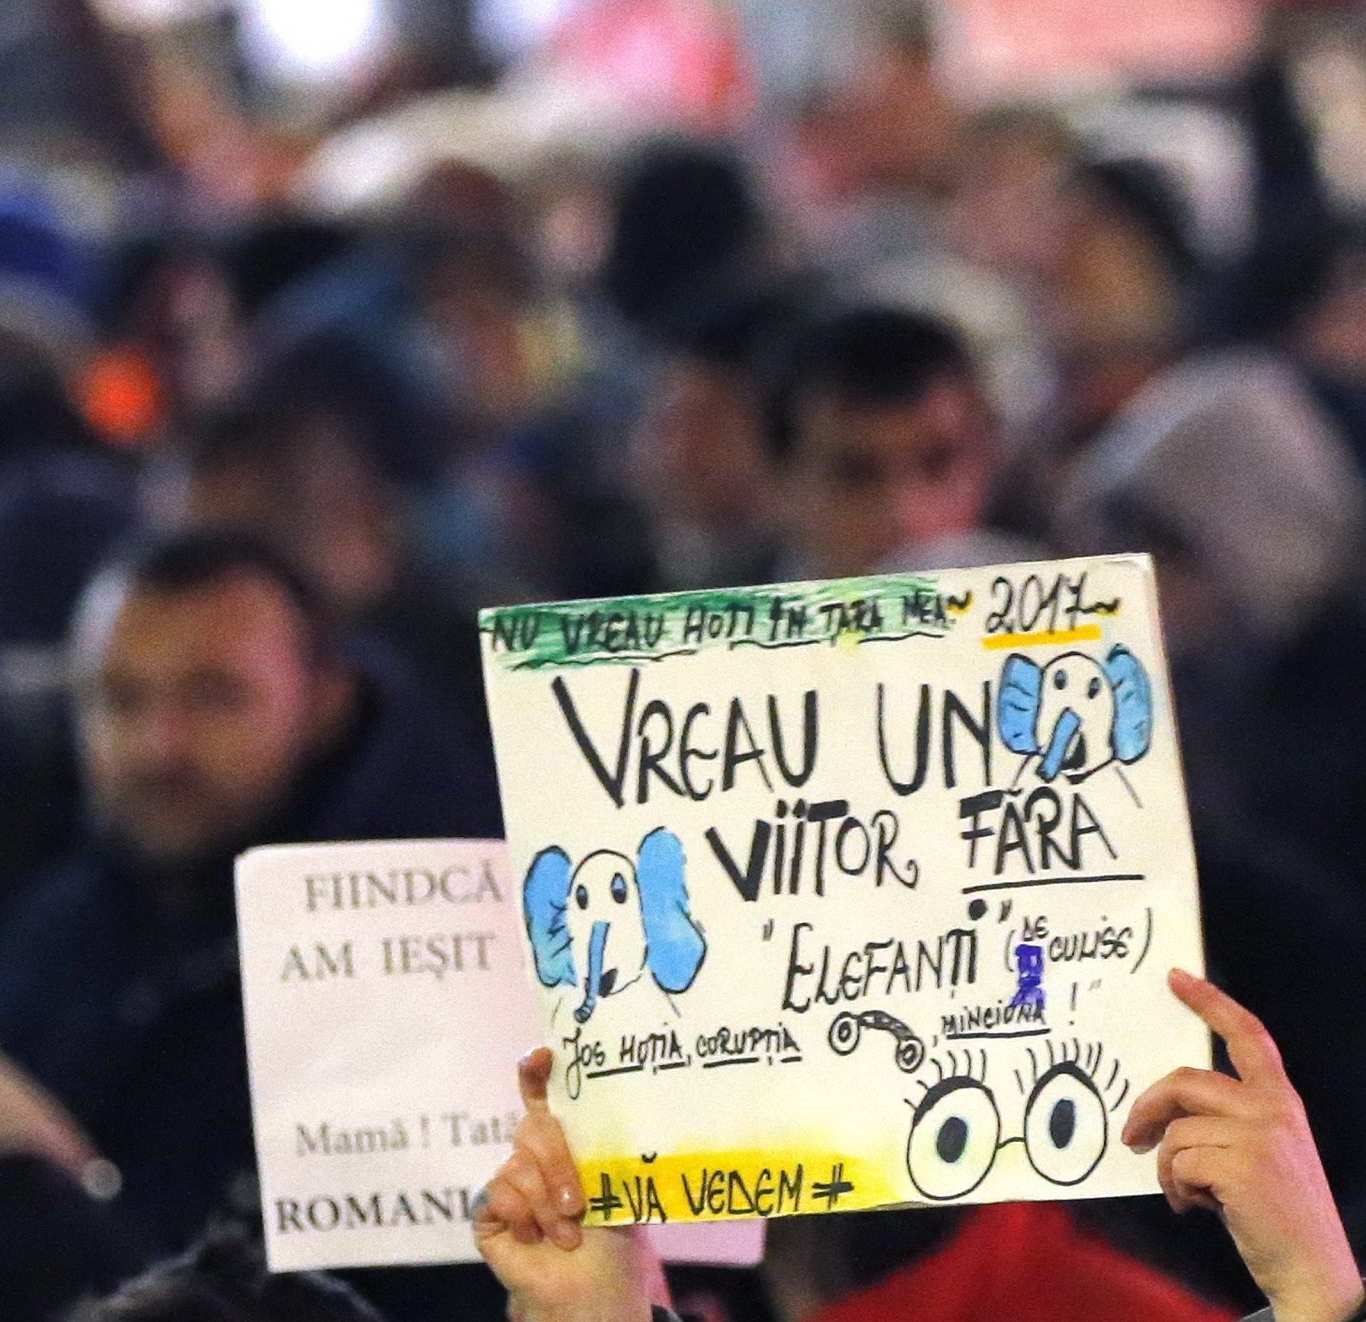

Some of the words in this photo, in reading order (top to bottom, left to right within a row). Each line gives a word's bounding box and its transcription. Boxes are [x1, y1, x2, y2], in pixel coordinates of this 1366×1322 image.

[561, 610, 665, 653] VREAU
[551, 667, 818, 809] VREAU
[877, 679, 992, 796] UN
[280, 938, 354, 982] AM
[275, 1185, 475, 1234] ROMANI
